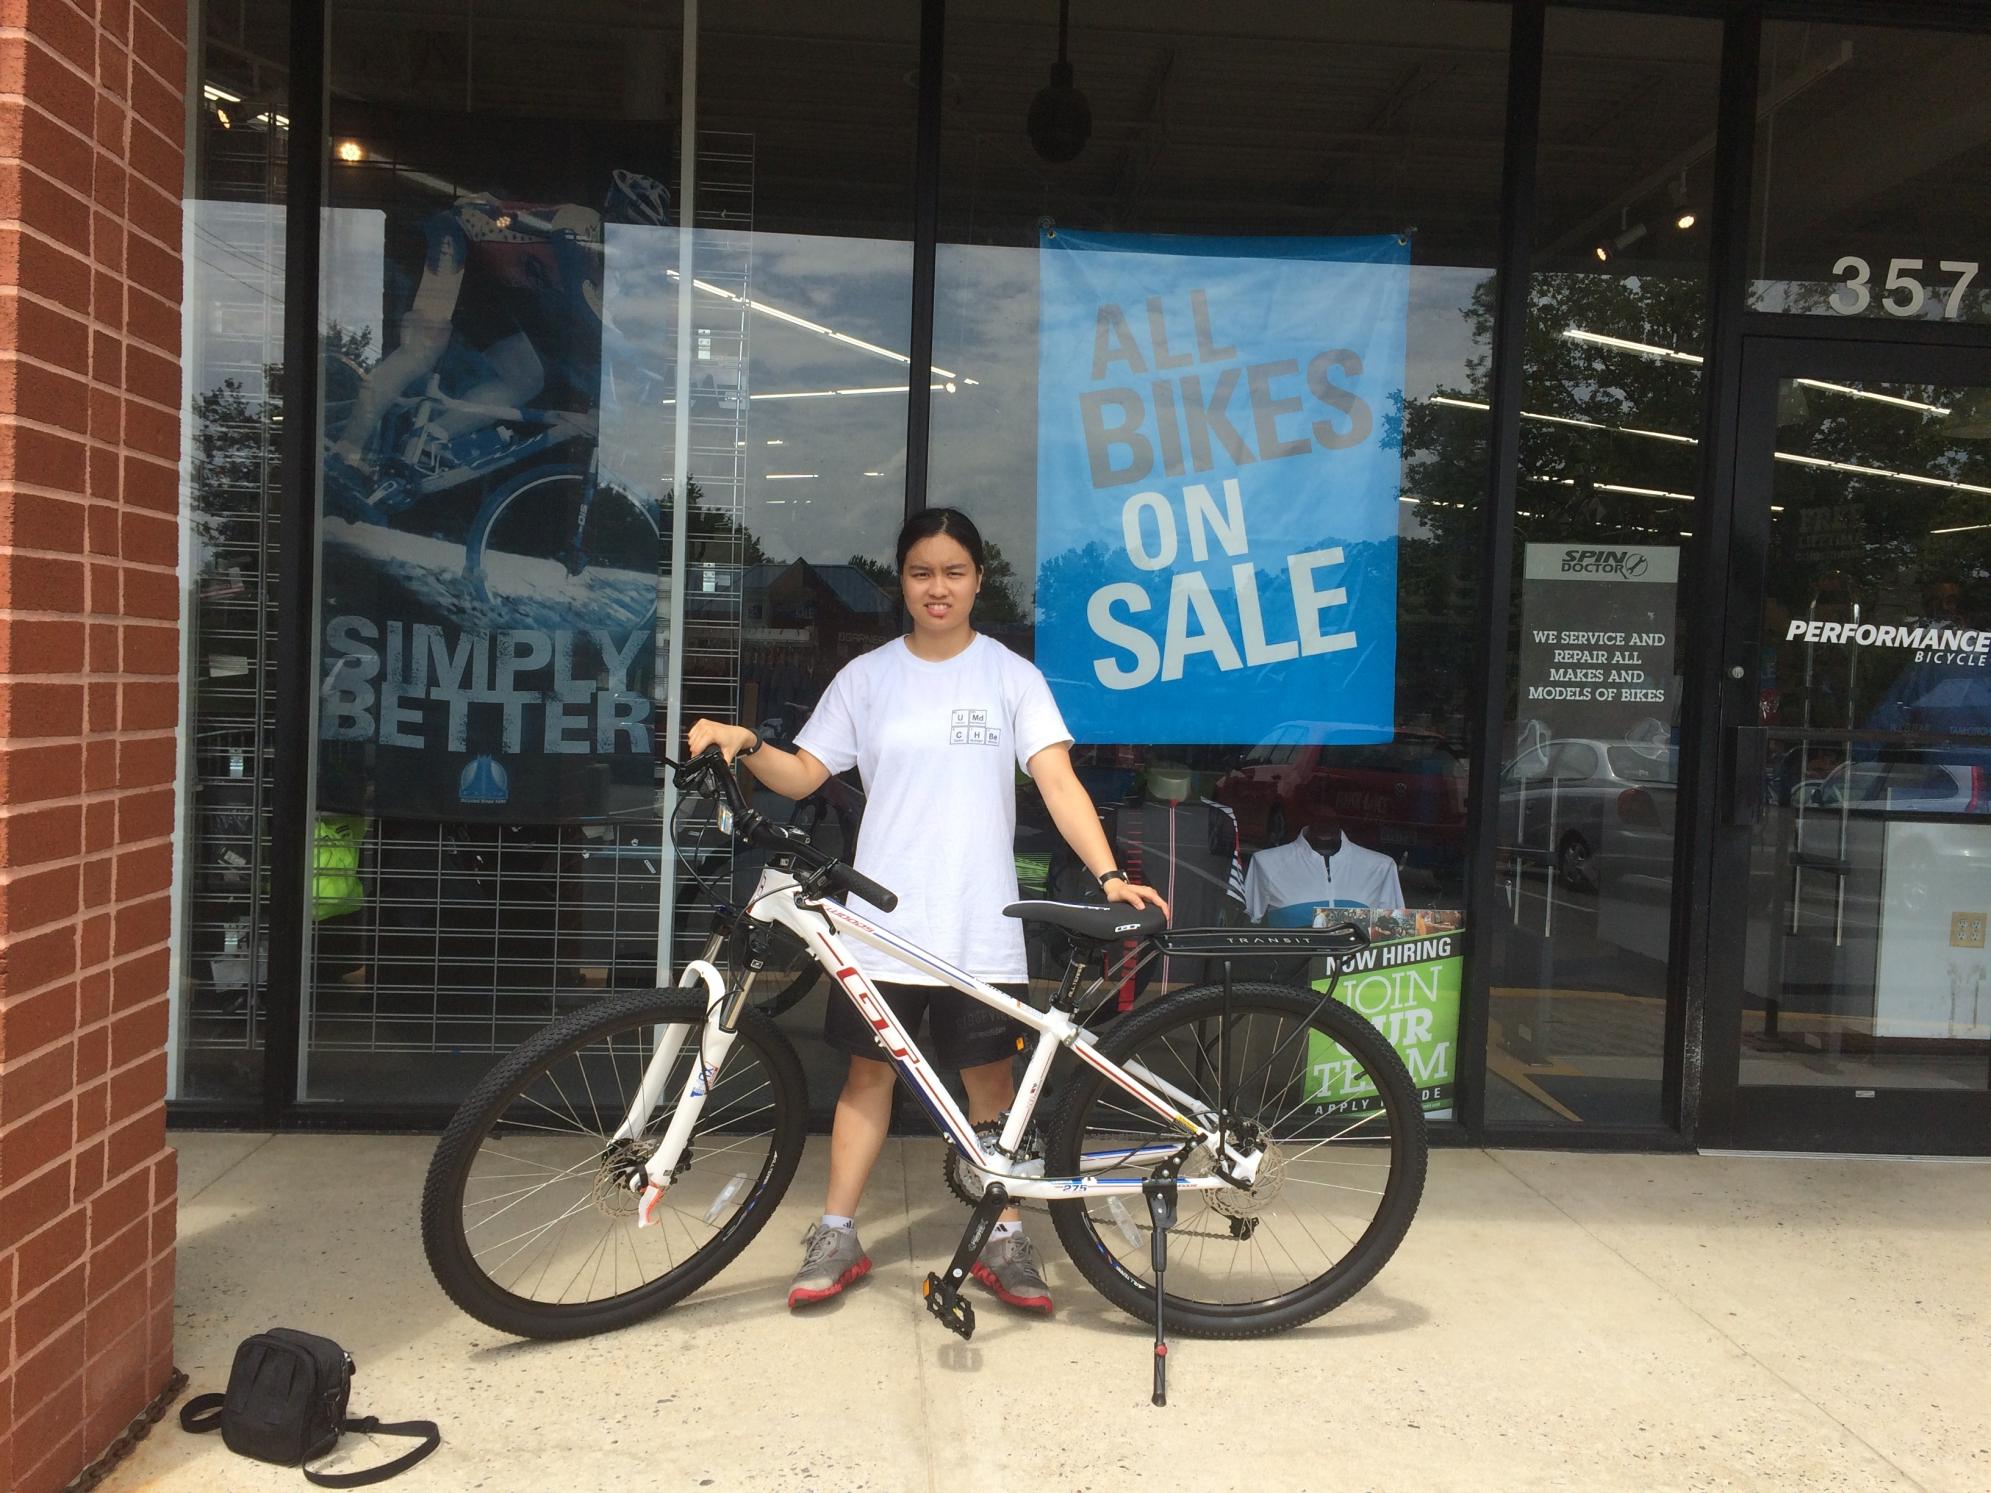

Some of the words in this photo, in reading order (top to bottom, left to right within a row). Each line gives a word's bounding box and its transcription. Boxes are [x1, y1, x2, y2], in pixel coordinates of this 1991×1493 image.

[1829, 256, 1979, 318] 357
[1090, 288, 1237, 380] ALL
[1078, 348, 1374, 490] BIKES
[1121, 478, 1249, 571] ON
[1561, 563, 1628, 578] DOCTOR
[1562, 550, 1628, 563] SPIN
[1086, 546, 1358, 691] SALE
[1533, 631, 1557, 644] WE
[1560, 632, 1625, 646] SERVICE
[1629, 634, 1665, 646] AND
[1786, 620, 1991, 652] PERFORMANCE
[325, 615, 651, 702] SIMPLY
[1549, 669, 1604, 682] MAKES
[1608, 670, 1645, 683] AND
[1554, 650, 1608, 663] REPAIR
[1611, 652, 1642, 664] ALL
[1914, 650, 1989, 667] BICYCLE
[1528, 687, 1592, 700] MODELS
[1595, 688, 1617, 701] OF
[1620, 689, 1665, 702] BIKES
[320, 680, 651, 754] BETTER
[1382, 937, 1452, 966] HIRING
[1343, 965, 1443, 1014] JOIN
[1334, 1008, 1433, 1056] UR
[1314, 1042, 1450, 1097] TEM
[1315, 1098, 1370, 1115] APPLY
